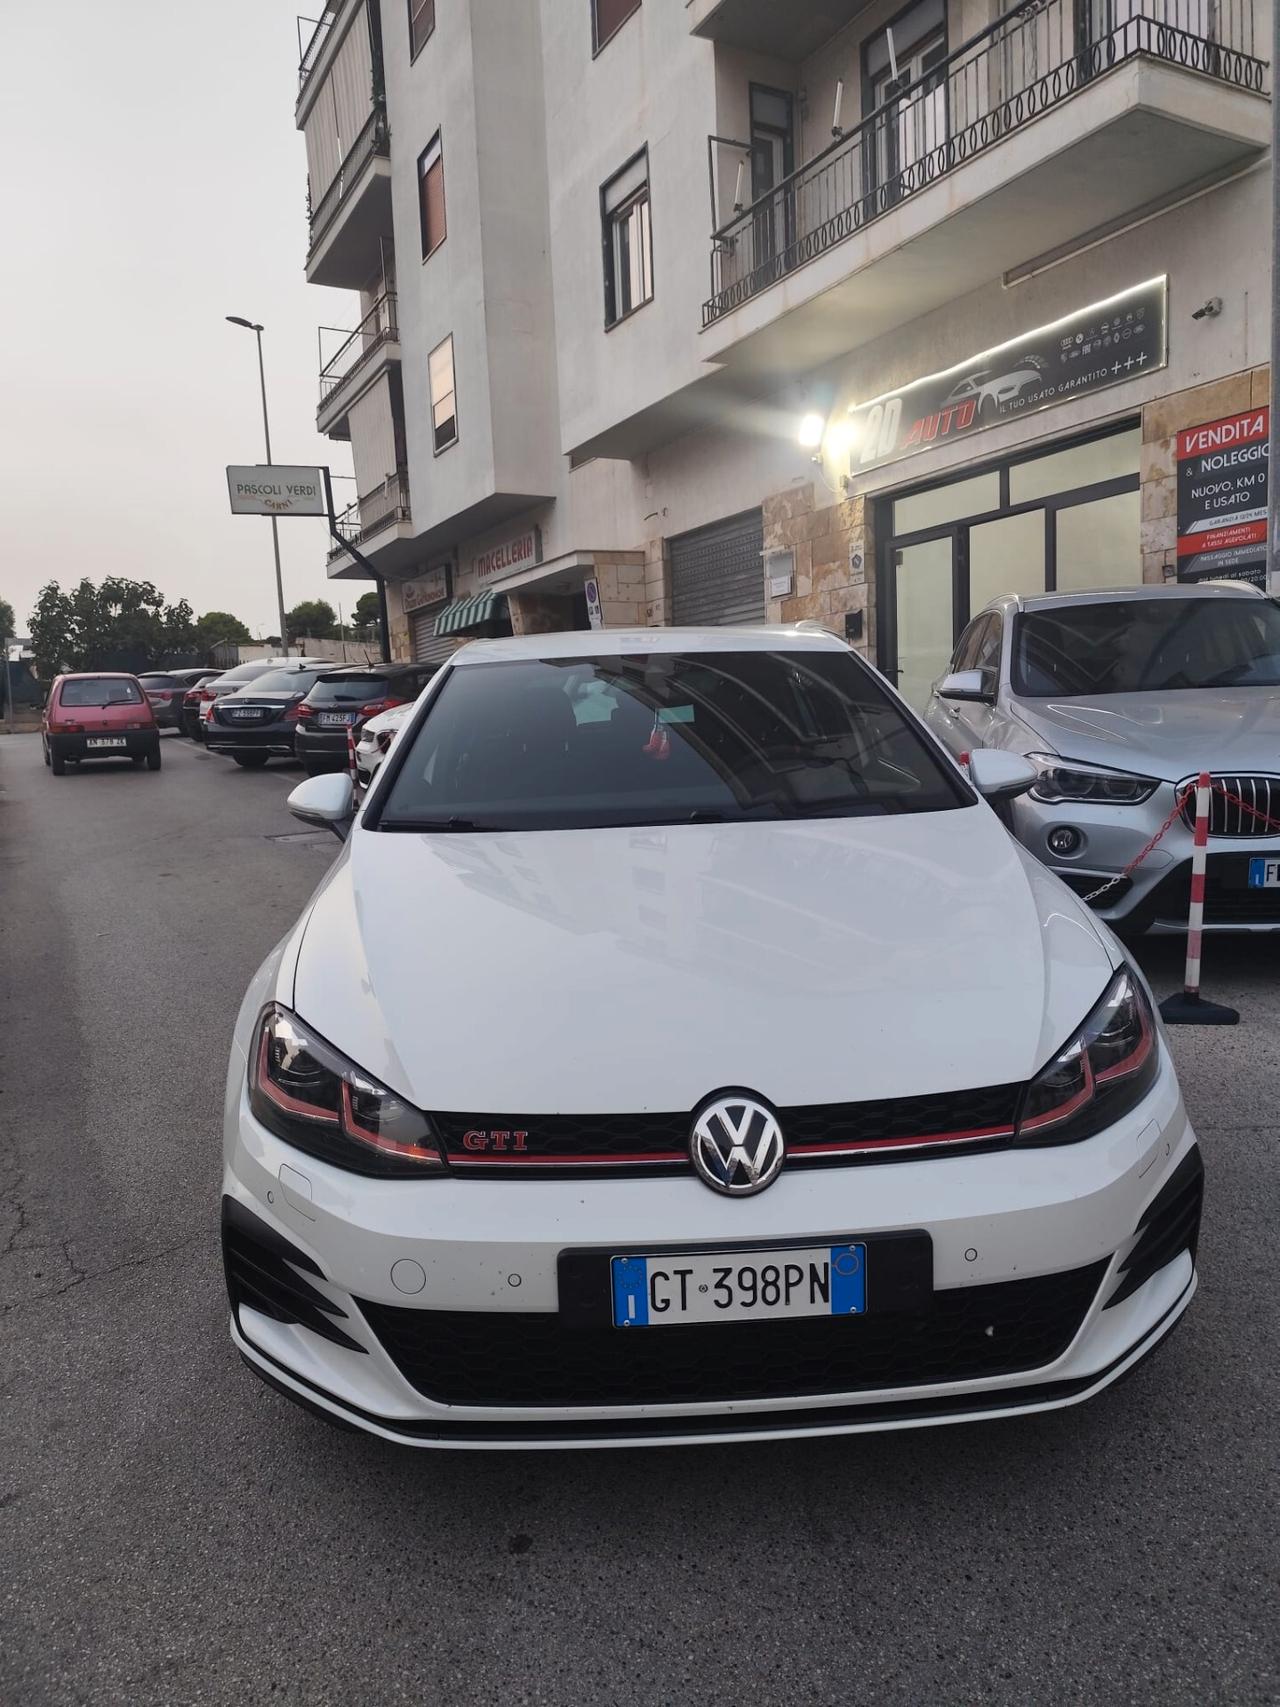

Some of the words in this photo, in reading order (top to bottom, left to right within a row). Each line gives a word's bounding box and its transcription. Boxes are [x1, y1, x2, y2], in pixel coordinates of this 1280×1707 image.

[1009, 398, 1026, 411] TUO
[1028, 386, 1056, 403] USATO
[1058, 368, 1108, 393] GARANTITO
[900, 399, 977, 450] AUTO
[1185, 414, 1264, 453] VENDITA
[236, 484, 282, 495] PASCOLI
[286, 485, 316, 496] VERDI
[1205, 500, 1211, 510] E
[1213, 491, 1250, 507] USATO
[1236, 474, 1255, 488] KM
[478, 535, 533, 577] MACELLERIA
[462, 1130, 528, 1150] GTI
[650, 1268, 693, 1313] GT
[712, 1262, 830, 1309] 398PN
